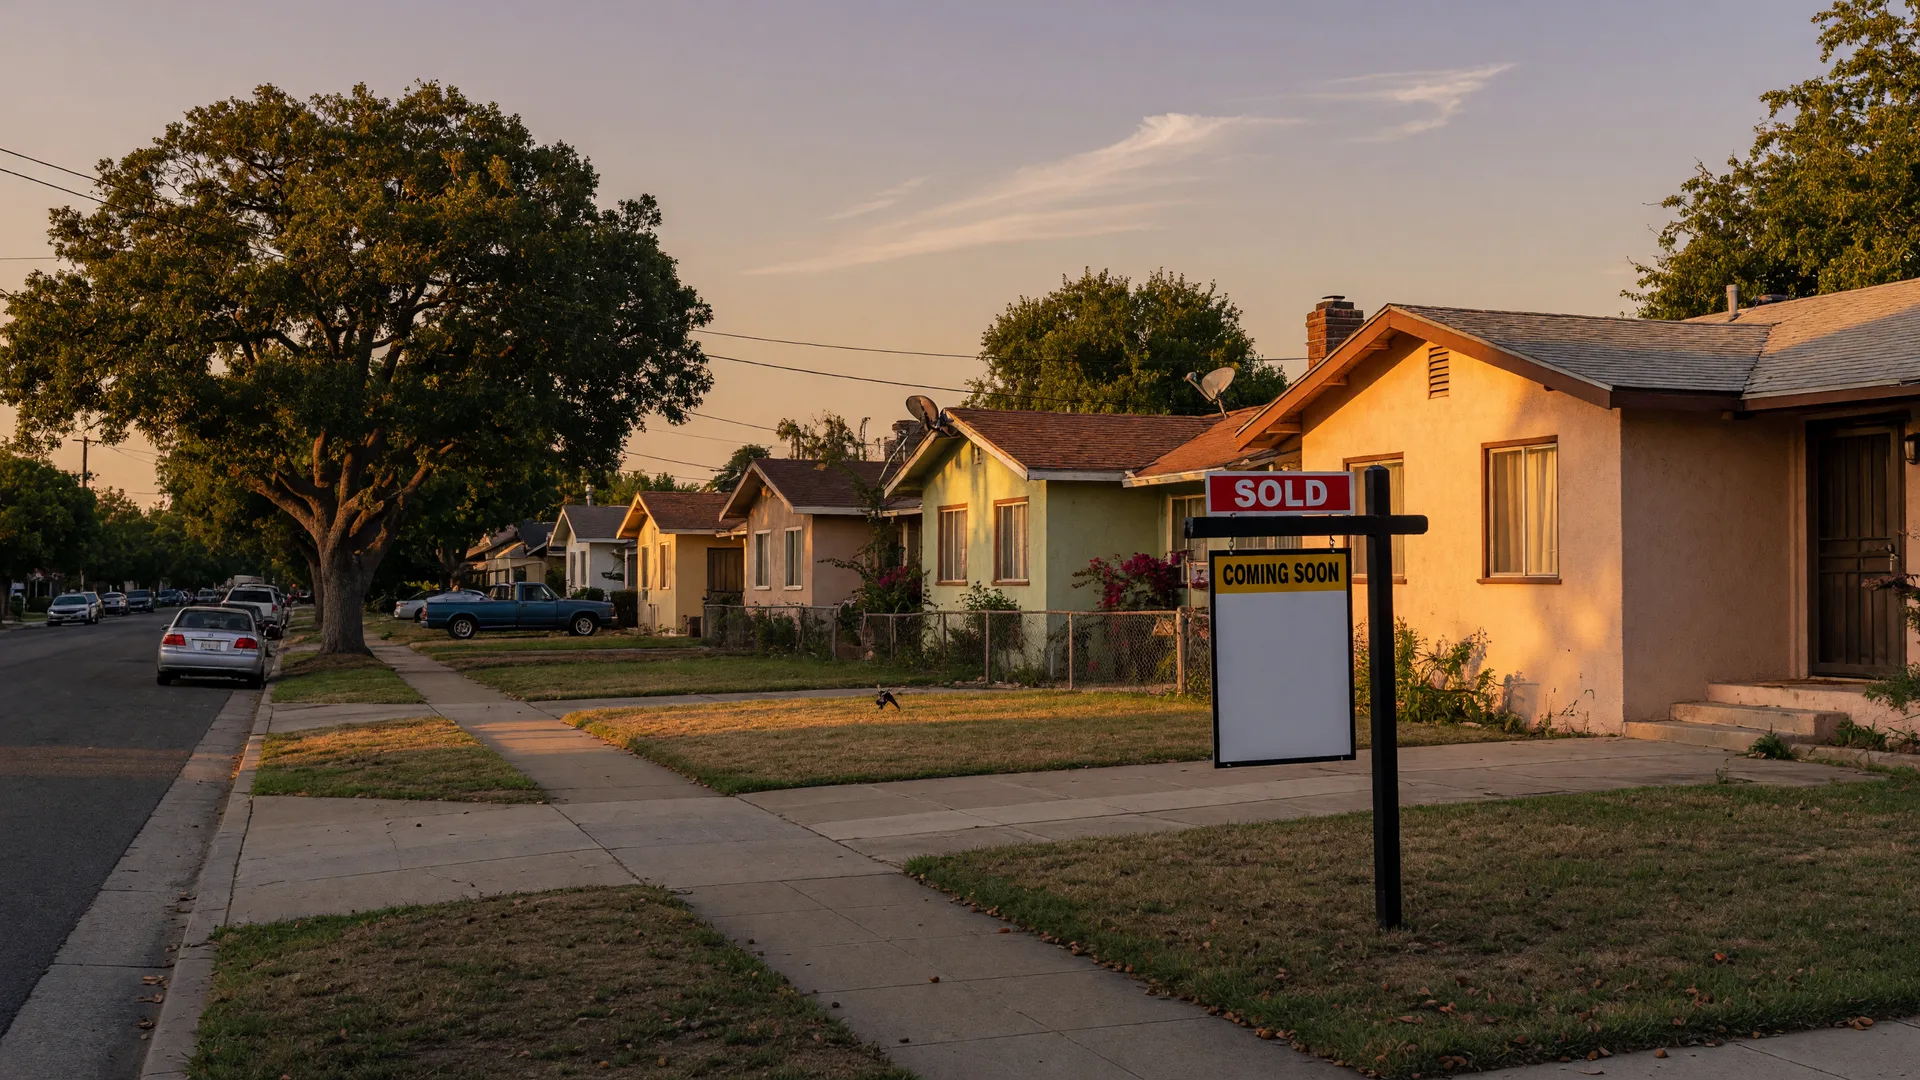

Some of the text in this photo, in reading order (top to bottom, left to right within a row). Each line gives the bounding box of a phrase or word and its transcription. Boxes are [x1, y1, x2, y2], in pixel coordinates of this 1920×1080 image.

[1234, 479, 1327, 507] SOLD
[1223, 562, 1339, 585] COMING SOON
